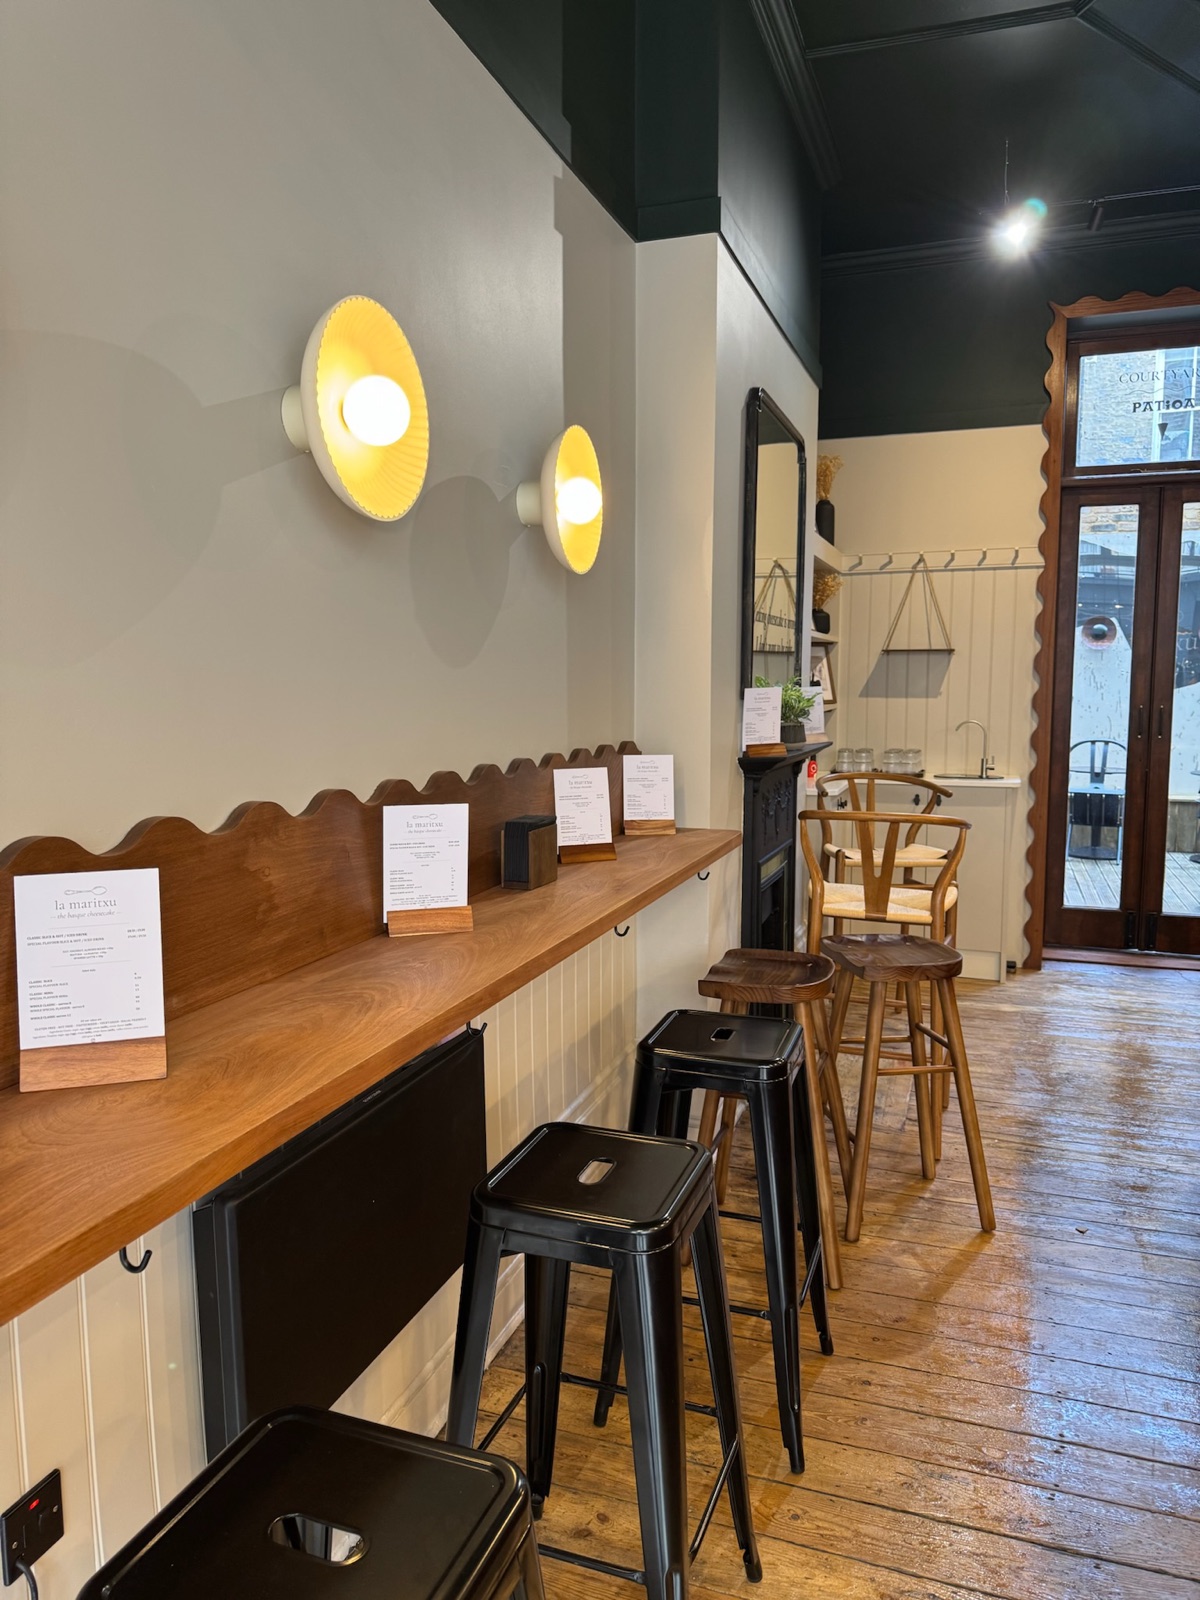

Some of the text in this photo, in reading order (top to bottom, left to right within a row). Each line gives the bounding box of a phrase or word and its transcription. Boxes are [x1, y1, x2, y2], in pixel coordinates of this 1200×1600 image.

[55, 898, 117, 910] la maritxu
[67, 911, 86, 920] basque
